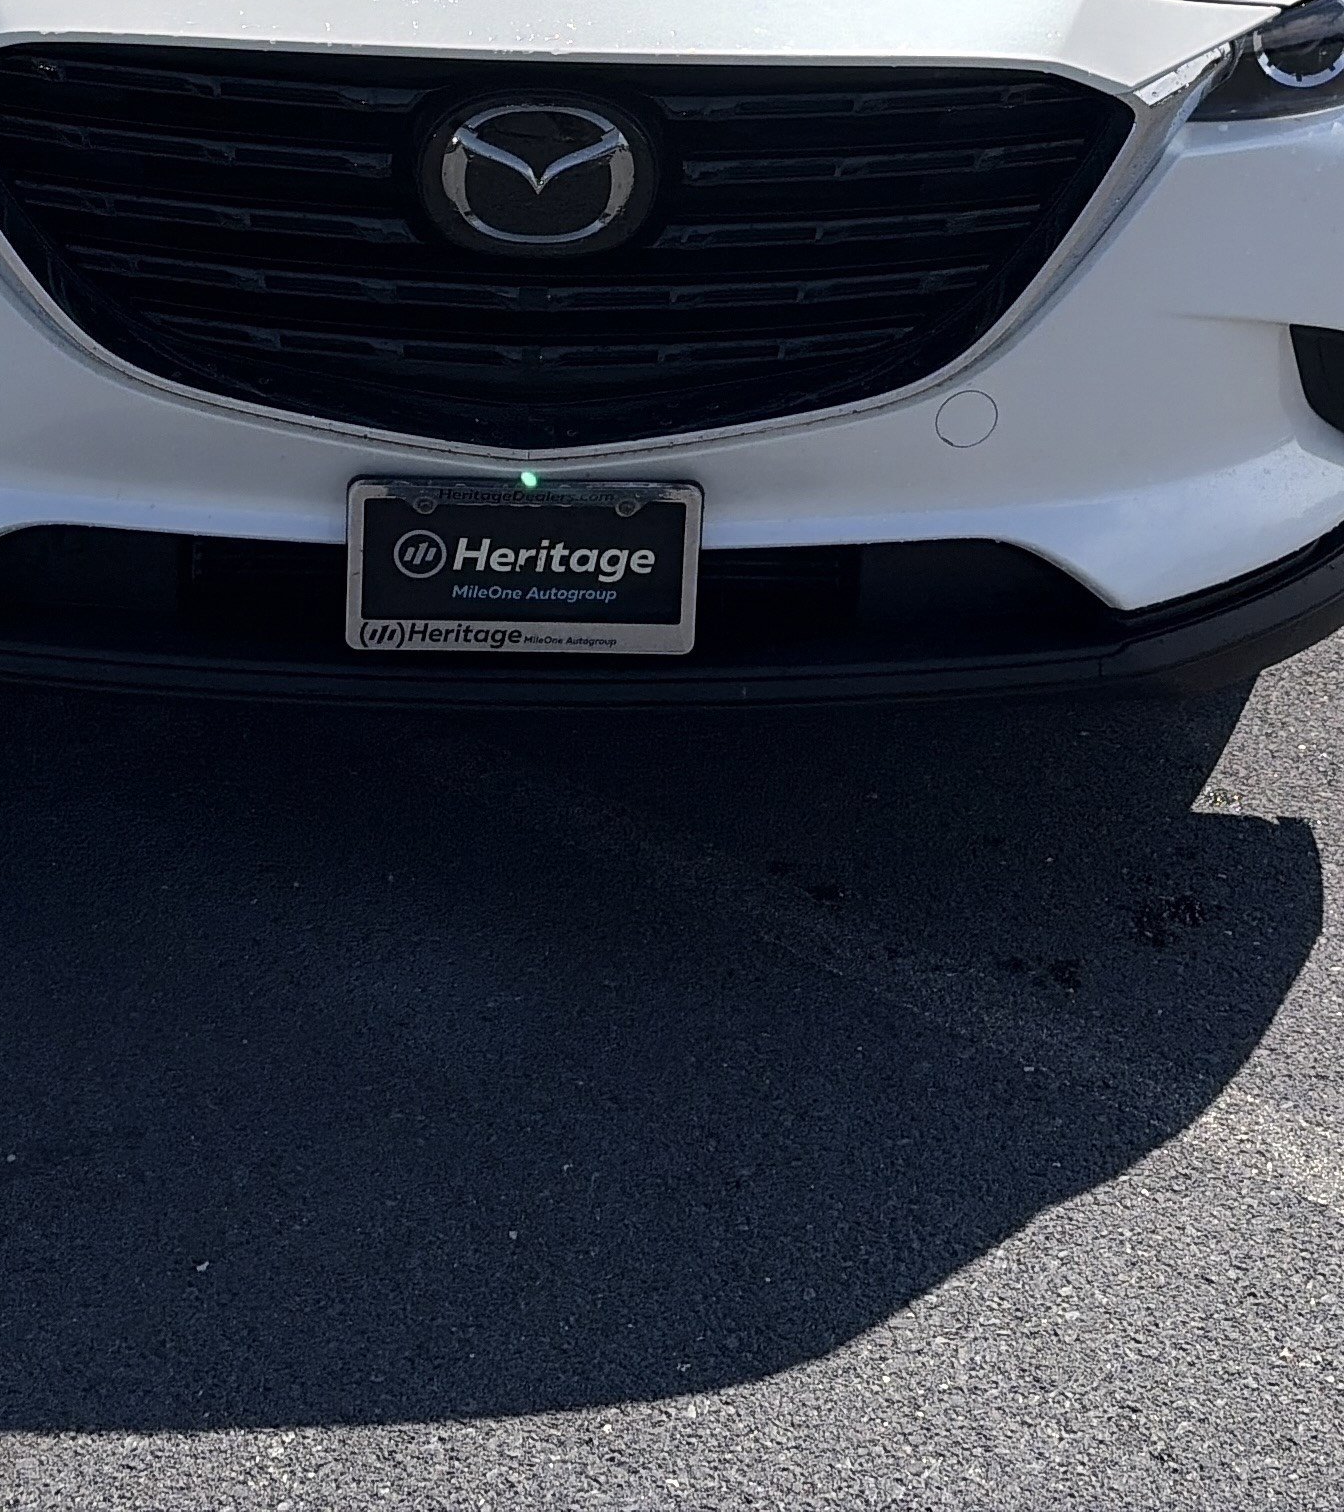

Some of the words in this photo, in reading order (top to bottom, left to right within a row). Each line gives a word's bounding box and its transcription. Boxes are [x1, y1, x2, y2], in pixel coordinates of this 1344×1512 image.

[452, 537, 655, 583] Heritage
[452, 585, 522, 600] MileOne
[526, 587, 618, 603] Autogroup
[407, 622, 523, 648] Heritage
[524, 635, 563, 645] MileOne
[566, 636, 617, 648] Autogroup
